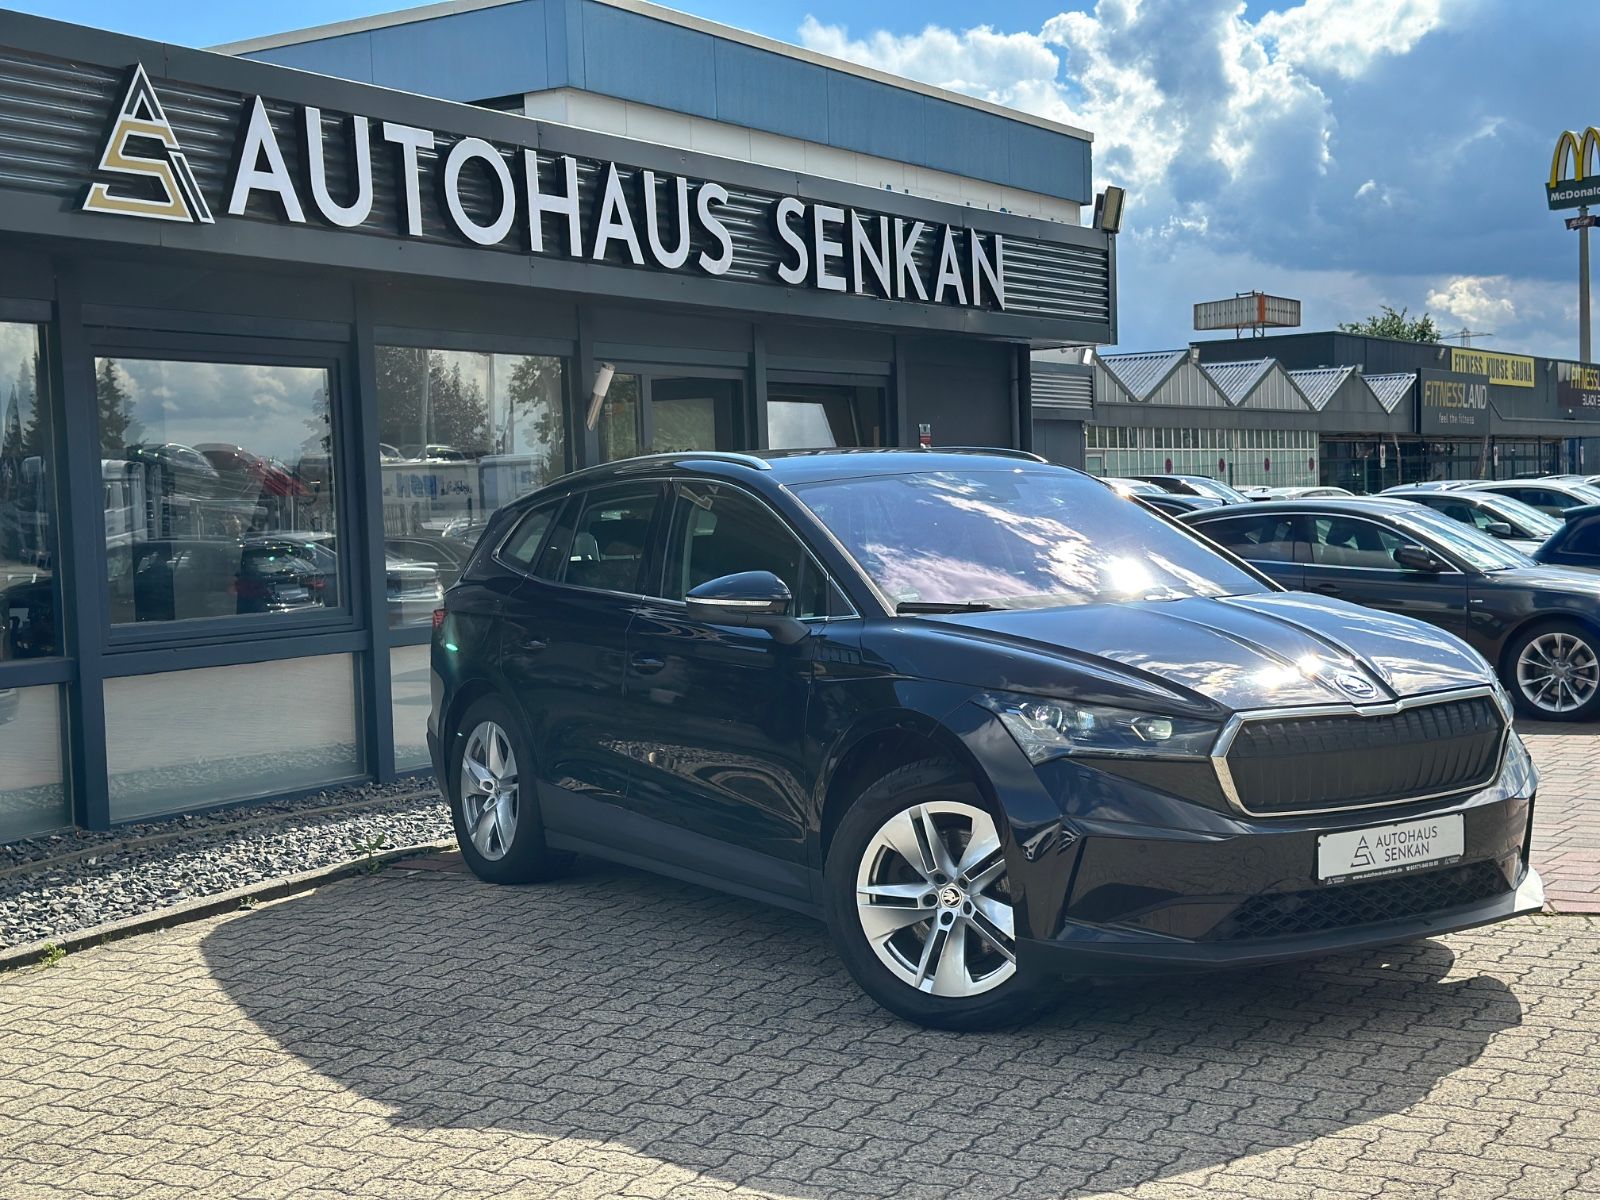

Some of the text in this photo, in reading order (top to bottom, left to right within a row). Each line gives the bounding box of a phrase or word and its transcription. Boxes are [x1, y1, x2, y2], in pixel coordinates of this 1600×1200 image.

[228, 95, 1006, 311] AUTOHAUS SENKAN
[1454, 353, 1532, 382] FITNESS KURSE SAUNA
[1424, 380, 1487, 410] FITNESSLAND
[1438, 411, 1475, 425] feel the fitness
[1375, 825, 1438, 848] AUTOHAUS
[1384, 841, 1430, 862] SENKAN
